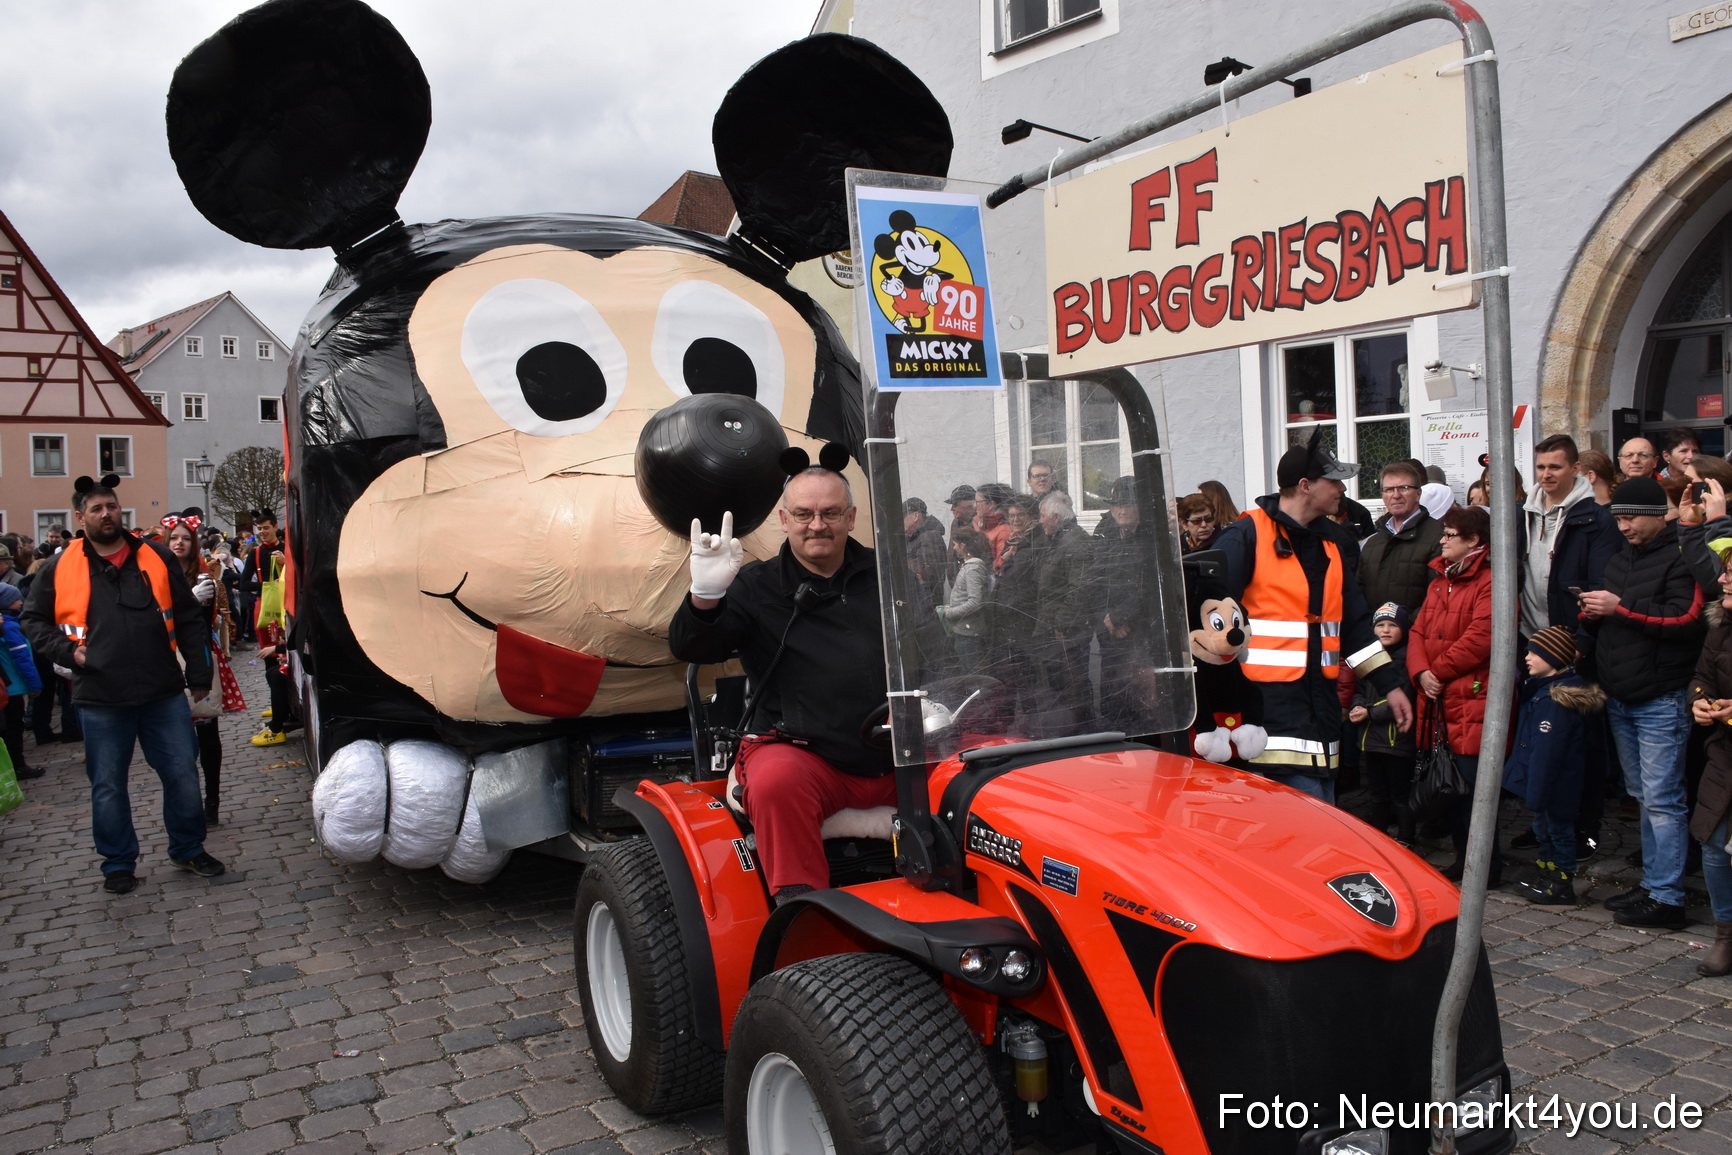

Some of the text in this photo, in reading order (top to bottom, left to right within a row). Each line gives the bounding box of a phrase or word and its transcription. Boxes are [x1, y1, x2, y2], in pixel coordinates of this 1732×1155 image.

[1129, 147, 1219, 252] FF
[1053, 176, 1469, 355] BURGGRIESBACH
[940, 285, 977, 320] 90
[938, 315, 977, 333] JAHRE
[900, 340, 973, 360] MICKY
[895, 362, 982, 372] DAS ORIGINAL
[1427, 422, 1463, 432] Bella
[1440, 431, 1480, 440] Roma
[970, 835, 1021, 866] CARRARO
[971, 825, 1022, 851] ANTONIO
[1102, 891, 1198, 933] TIGRE 4000
